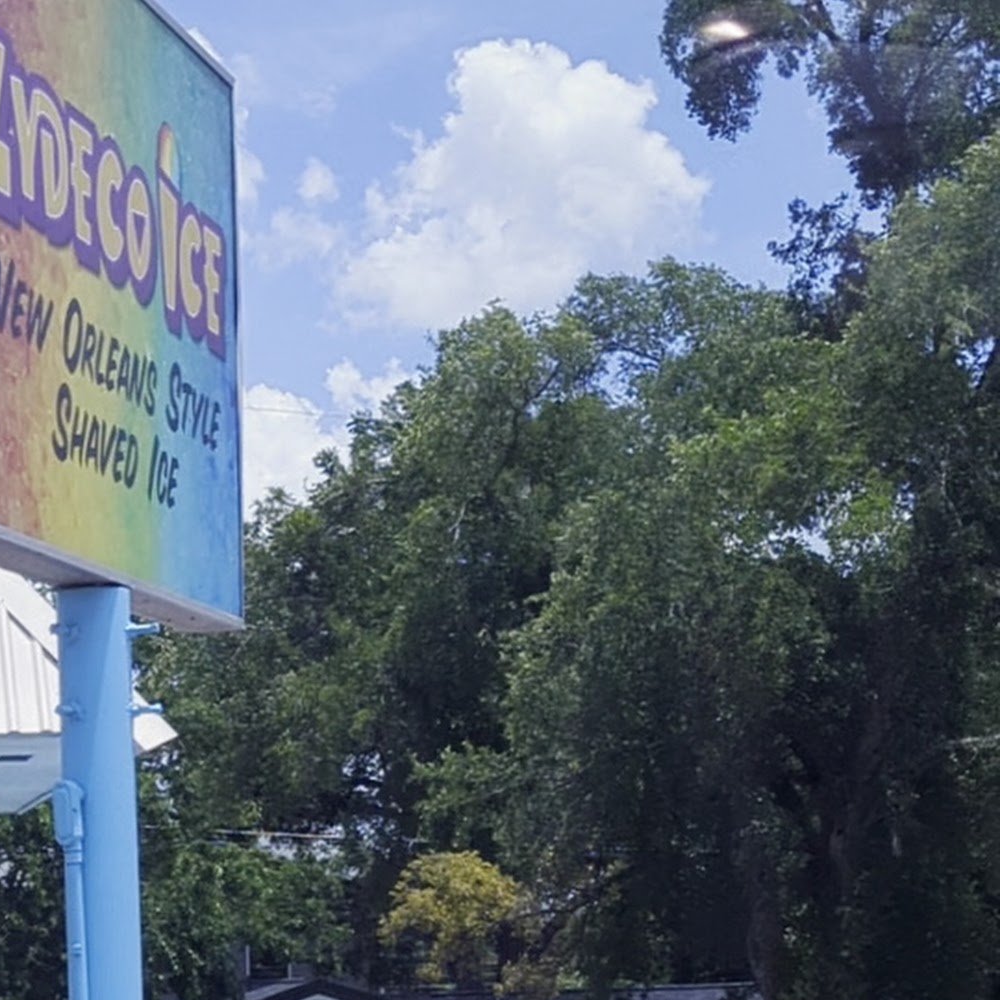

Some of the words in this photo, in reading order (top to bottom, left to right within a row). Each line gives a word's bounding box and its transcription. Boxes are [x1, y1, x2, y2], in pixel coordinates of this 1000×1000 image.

[157, 125, 222, 338] ICE
[52, 383, 137, 492] SHAVED
[148, 432, 179, 509] ICE
[62, 297, 158, 416] ORLEANS
[165, 362, 221, 452] STYLE
